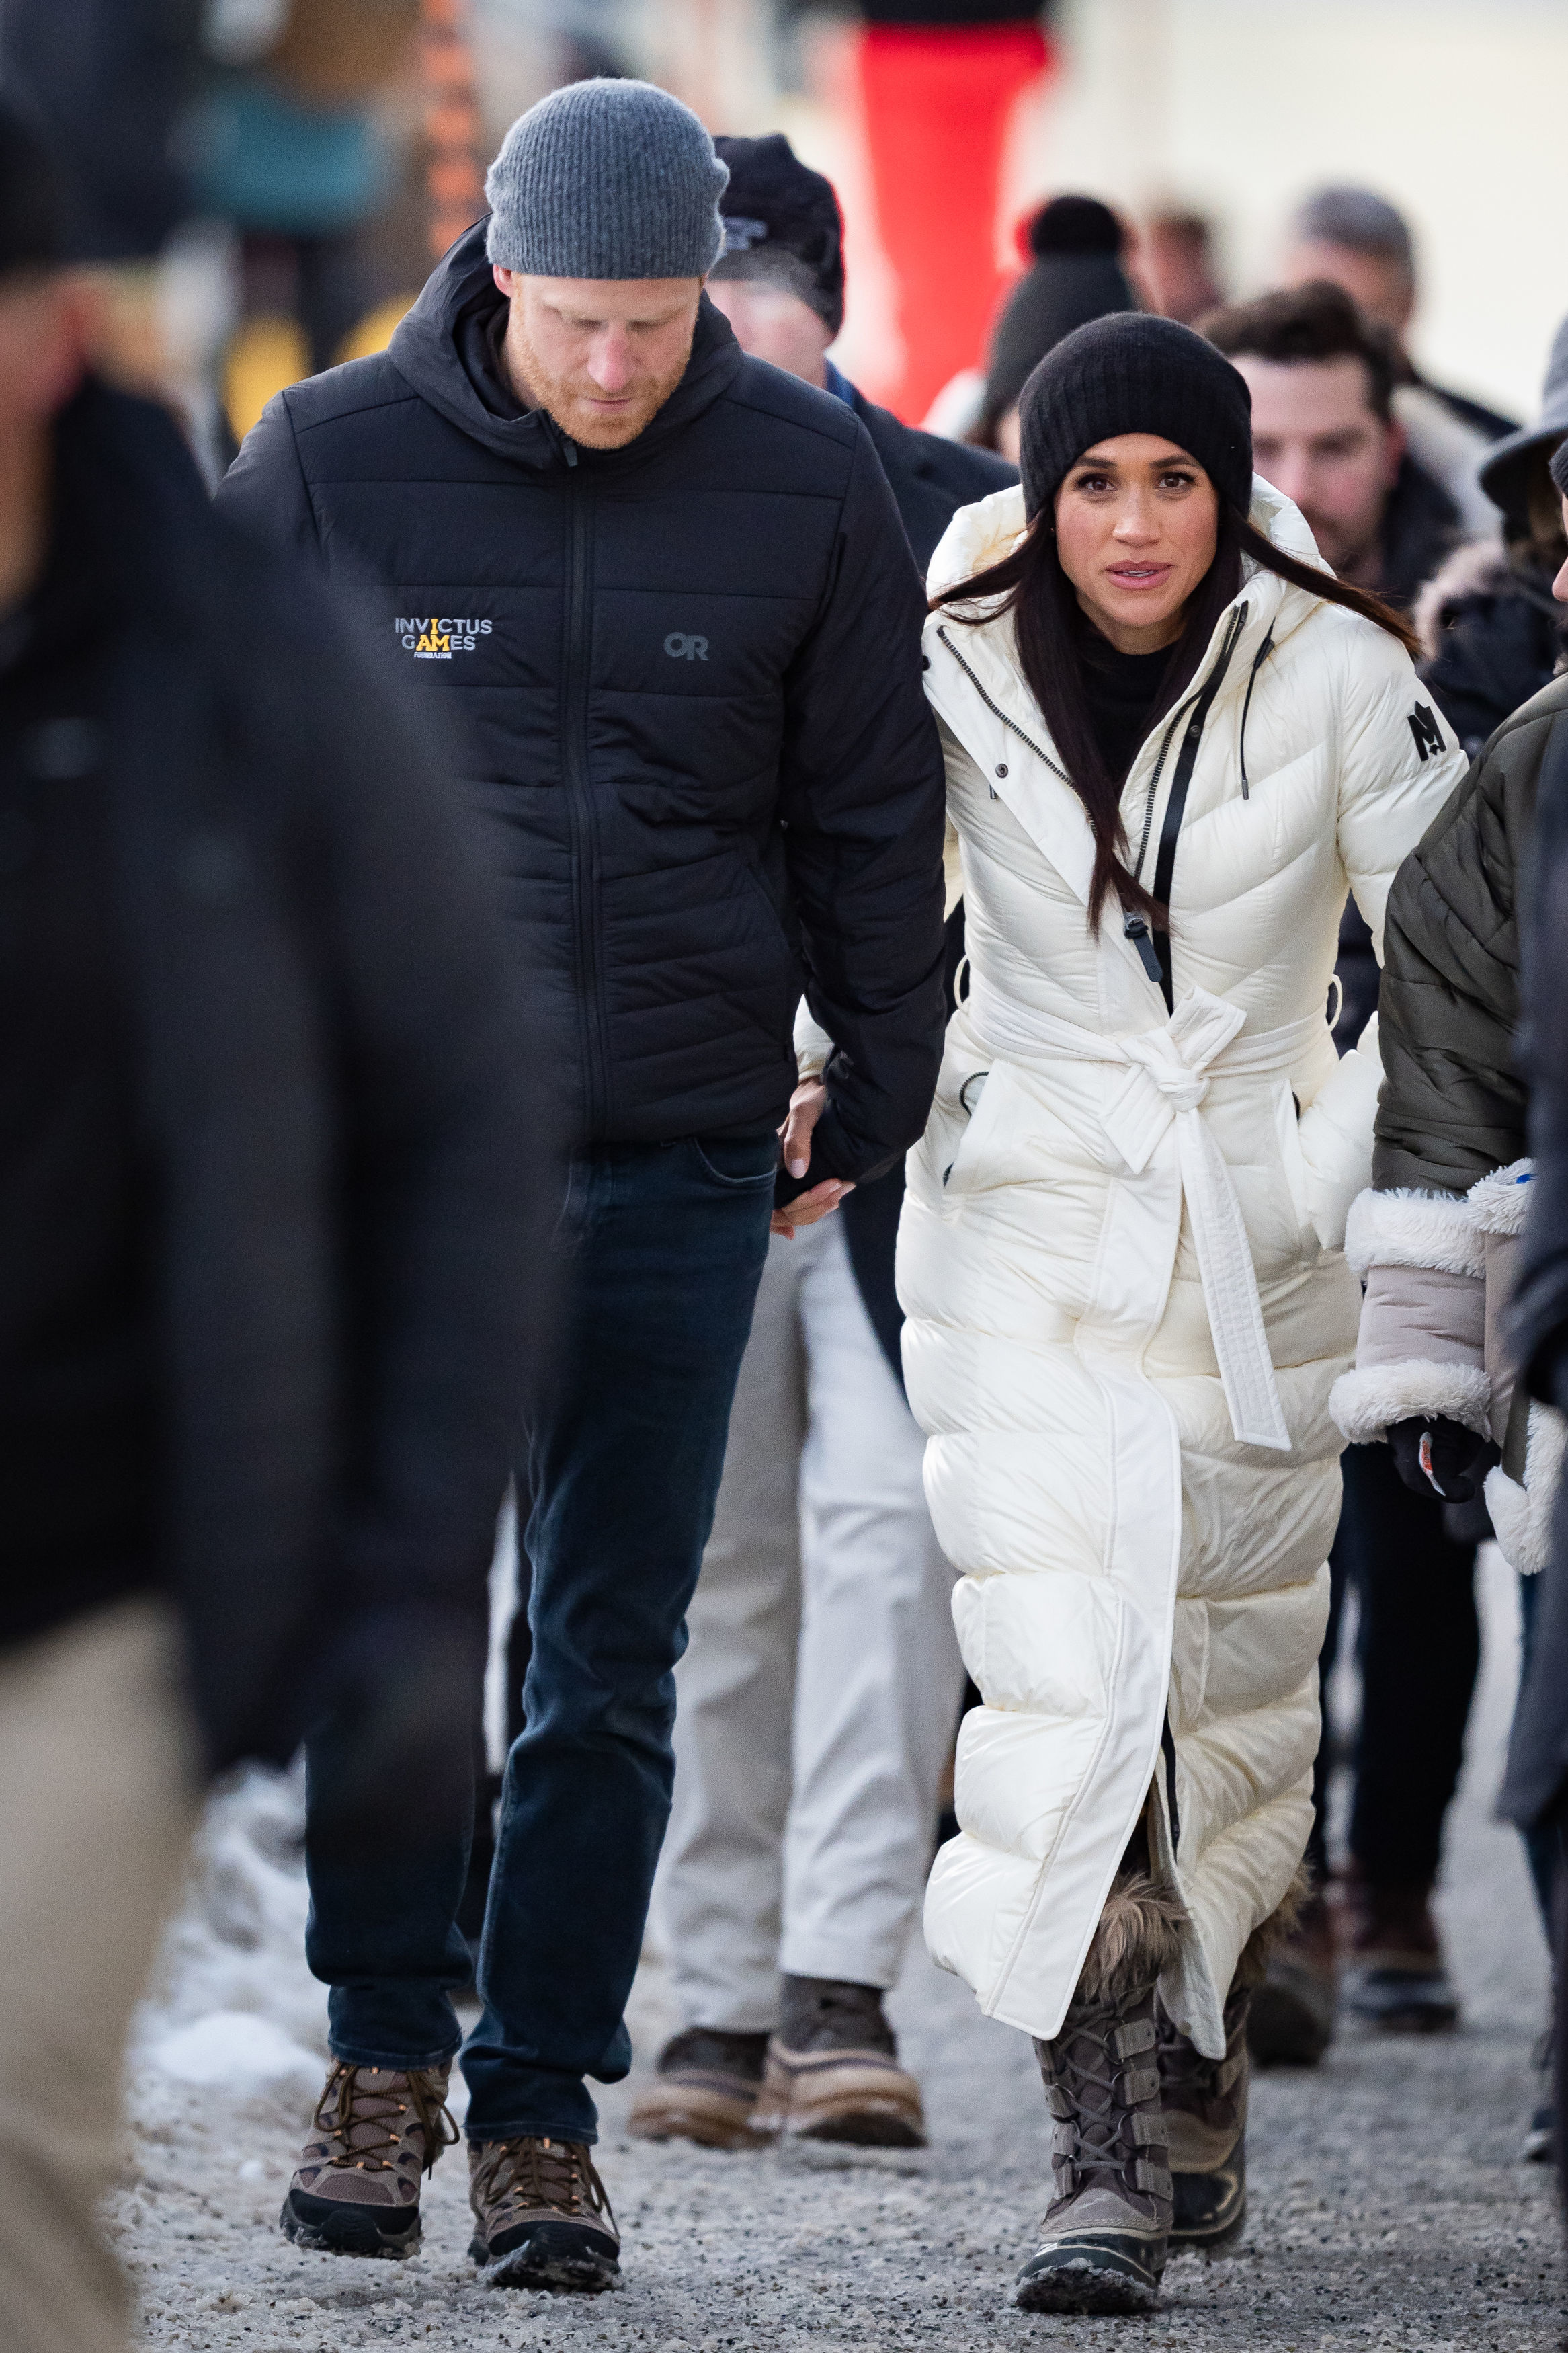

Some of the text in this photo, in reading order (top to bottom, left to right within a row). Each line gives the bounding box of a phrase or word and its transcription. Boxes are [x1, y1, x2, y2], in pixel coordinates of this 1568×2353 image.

[395, 617, 493, 635] INVICTUS
[402, 634, 476, 651] GAMES
[664, 632, 709, 660] OR
